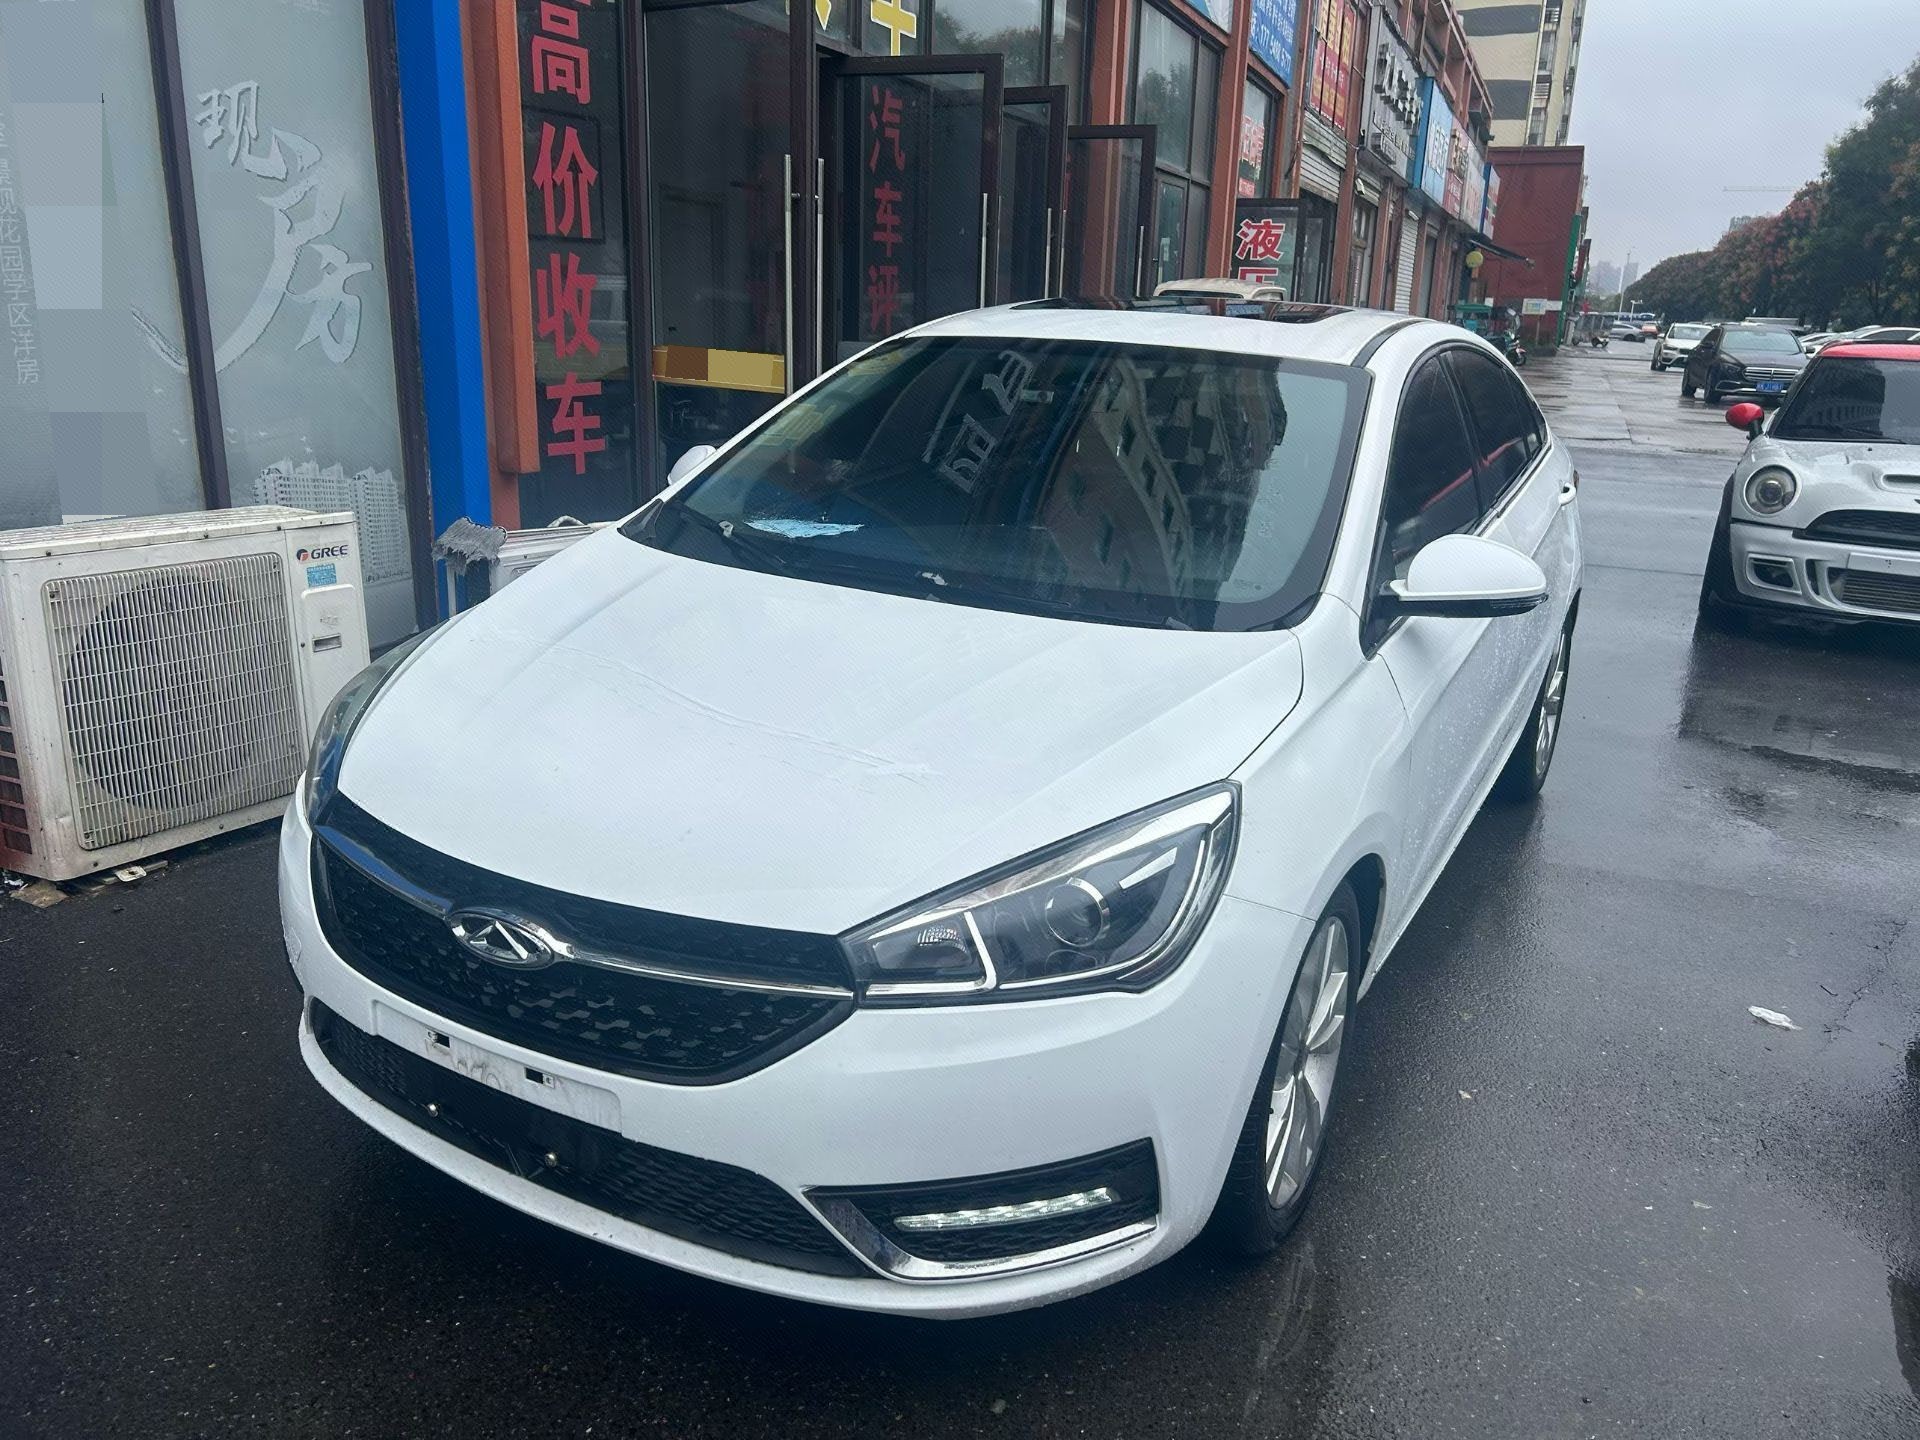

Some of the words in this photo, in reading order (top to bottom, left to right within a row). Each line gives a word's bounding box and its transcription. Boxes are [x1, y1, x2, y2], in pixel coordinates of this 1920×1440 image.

[532, 0, 608, 475] 高价收车
[310, 544, 349, 560] GREE
